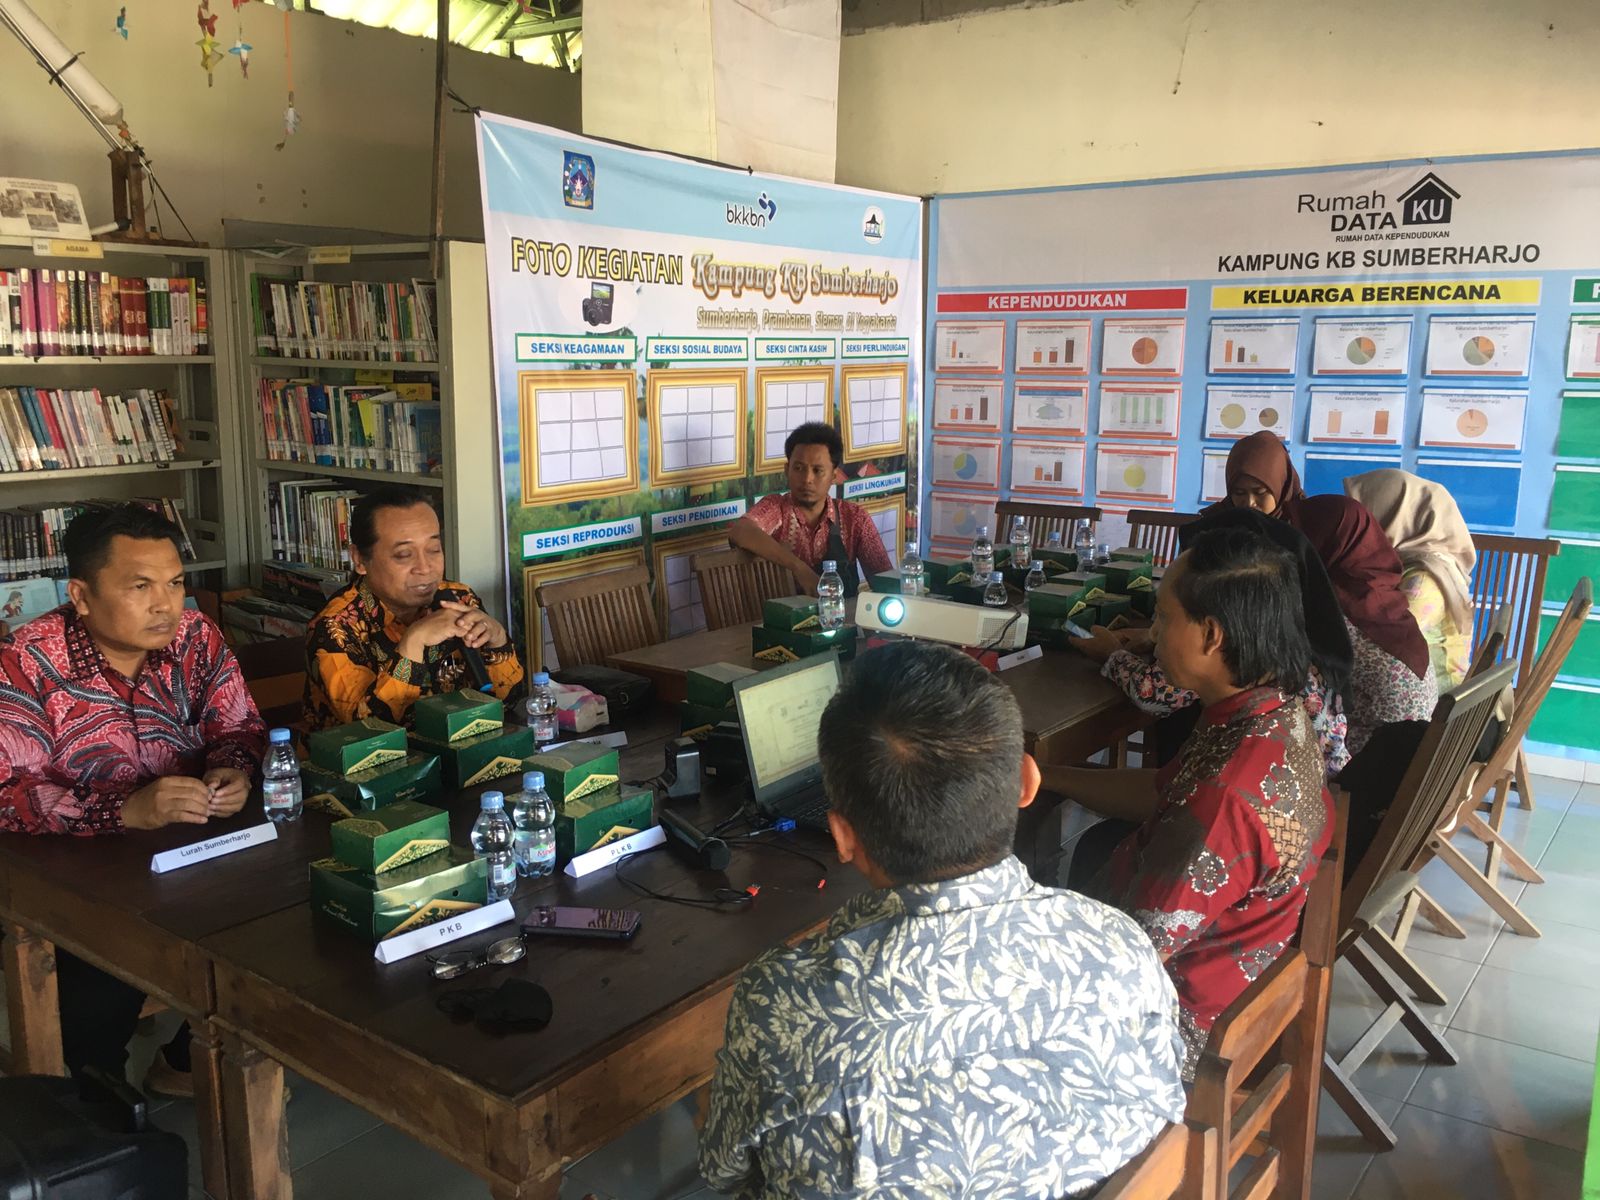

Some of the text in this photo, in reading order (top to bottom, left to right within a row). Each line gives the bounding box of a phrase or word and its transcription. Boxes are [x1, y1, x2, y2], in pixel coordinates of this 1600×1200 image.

[1297, 190, 1386, 213] Rumah
[1411, 198, 1445, 222] KU
[726, 203, 766, 227] bkkbn
[1330, 211, 1398, 232] DATA
[1335, 230, 1450, 243] RUMAH DATA KEPENDUDUKAN
[511, 236, 683, 285] FOTO KEGIATAN
[1218, 244, 1541, 273] KAMPUNG KB SUMBERHARJO
[692, 253, 898, 304] Kampung KB Sumberharjo
[988, 293, 1127, 309] KEPENDUDUKAN
[1243, 284, 1501, 305] KELUARGA BERENCANA
[530, 342, 625, 355] SEKSI KEAGAMAAN
[654, 344, 743, 355] SEKSI SOSIAL BUDAYA
[766, 344, 828, 354] SEKSI CINTA KASIH
[846, 344, 862, 352] SEKSI
[848, 484, 863, 494] SEKSI
[662, 505, 738, 527] SEKSI PENDIDIKAN
[536, 523, 635, 549] SEKSI REPRODUKSI
[181, 832, 251, 857] Lurah Sumberharjo
[611, 843, 633, 856] PLKB
[439, 922, 463, 936] PKB
